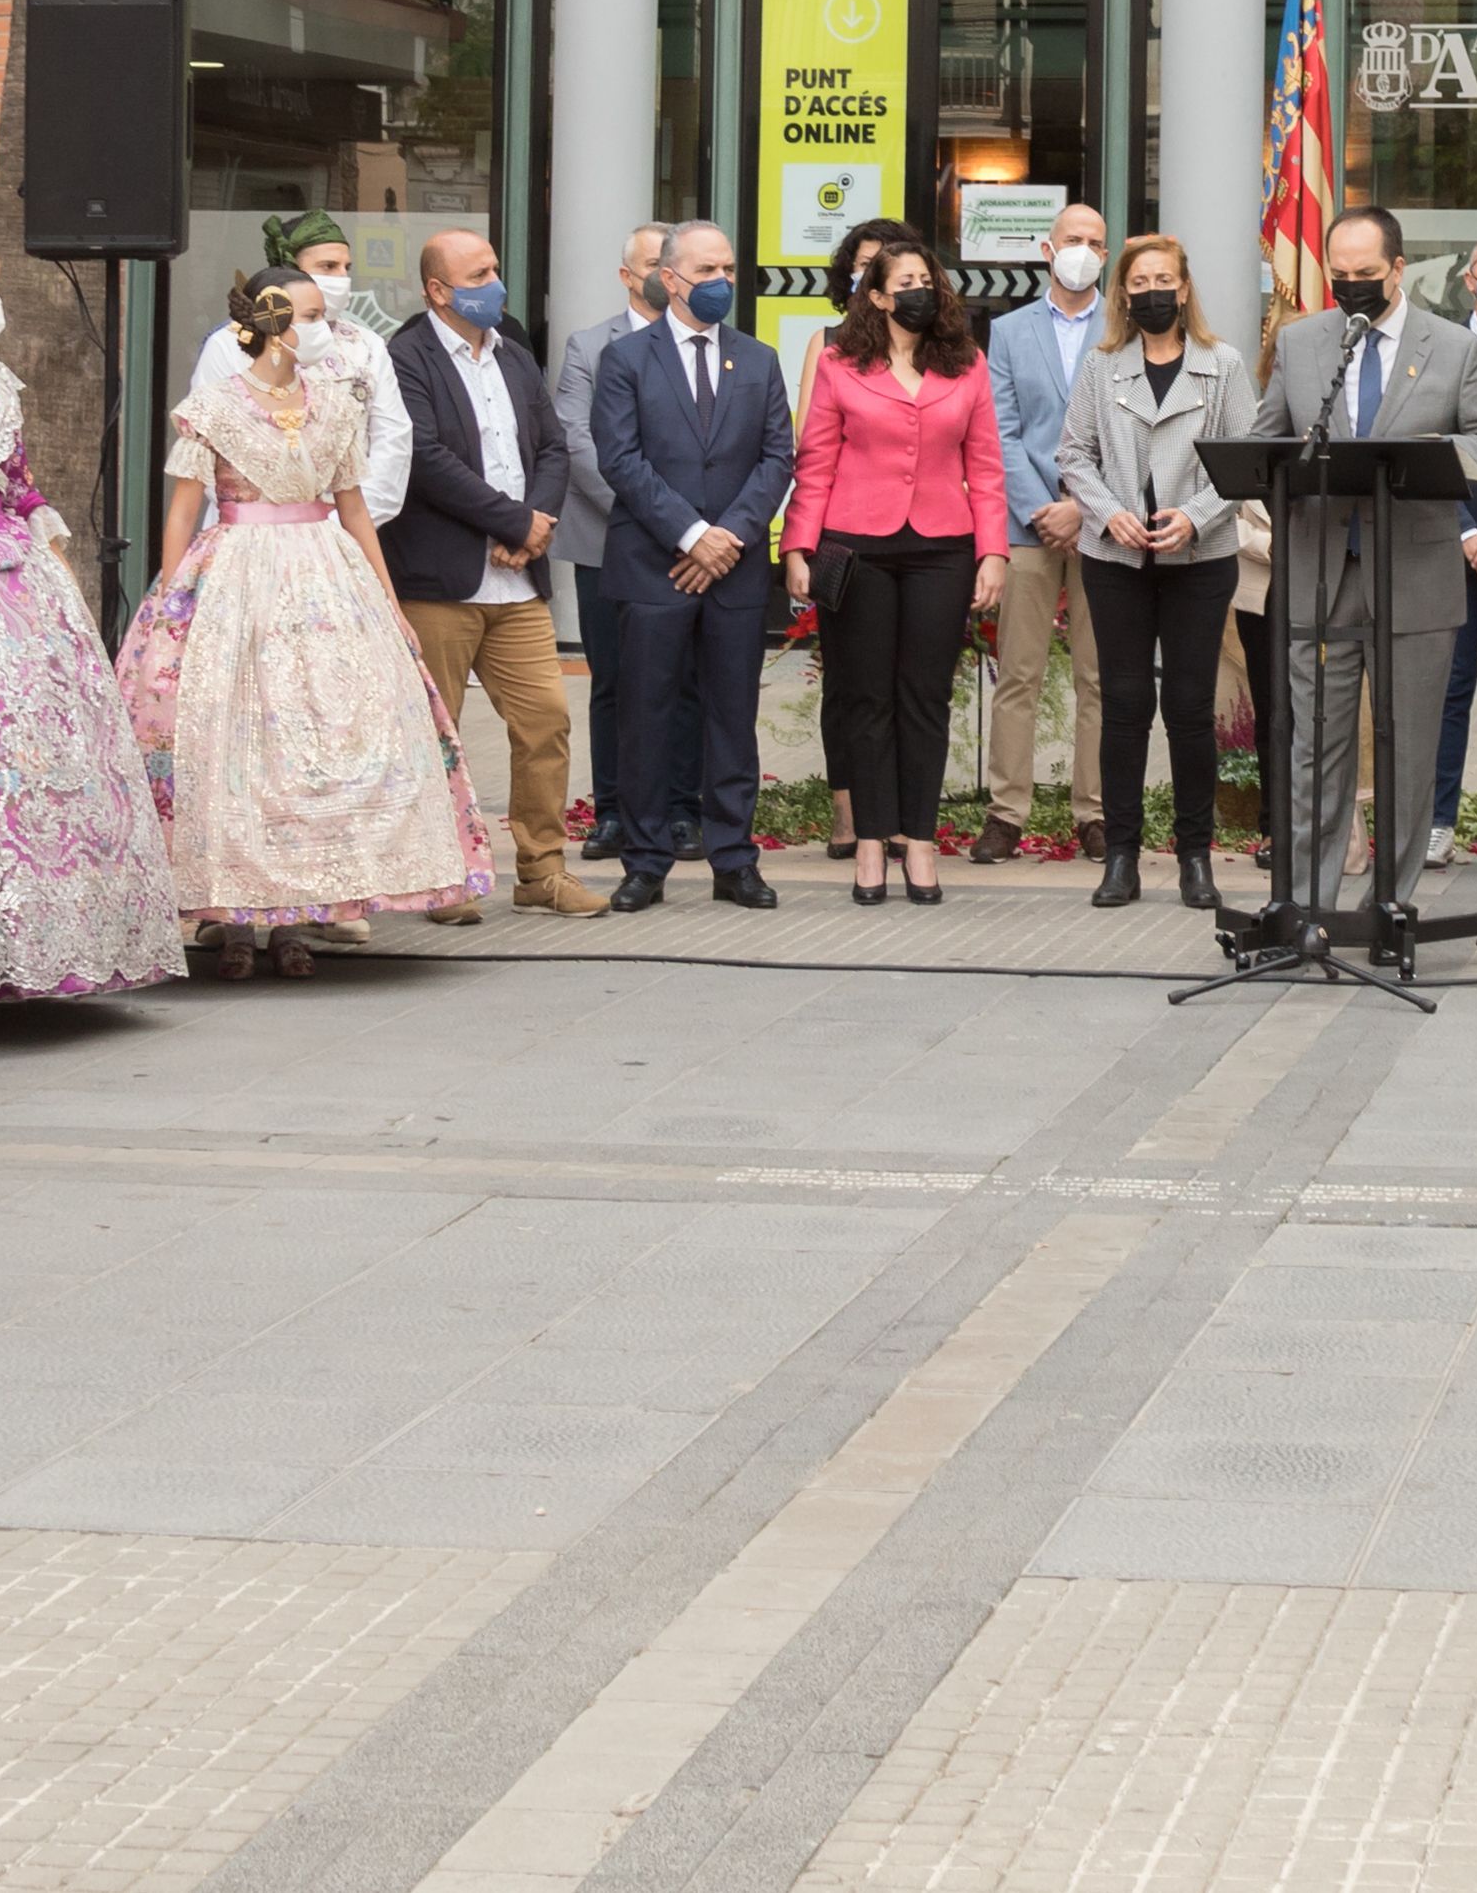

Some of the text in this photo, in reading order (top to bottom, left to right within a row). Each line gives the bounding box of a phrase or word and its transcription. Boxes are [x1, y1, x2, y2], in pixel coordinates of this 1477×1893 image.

[785, 68, 852, 89] PUNT
[784, 91, 887, 117] D'ACCÉS
[783, 122, 876, 144] ONLINE
